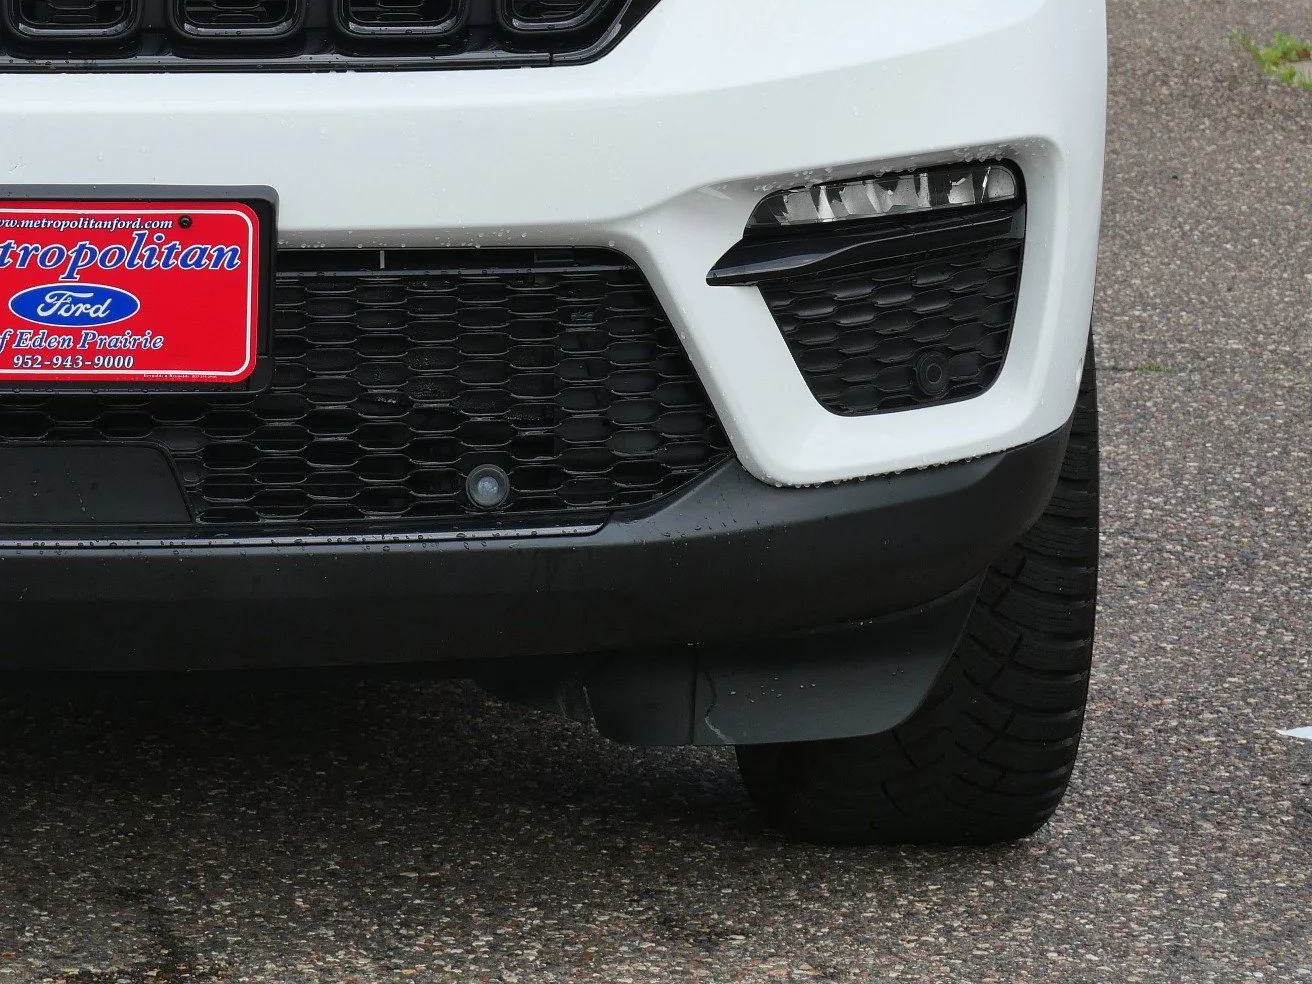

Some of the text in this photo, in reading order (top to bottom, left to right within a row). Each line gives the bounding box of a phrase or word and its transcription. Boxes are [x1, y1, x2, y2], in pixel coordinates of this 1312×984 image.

[36, 290, 113, 318] Ford
[12, 330, 74, 350] Eden
[77, 330, 164, 350] Prairie
[13, 354, 135, 369] 952-943-9000
